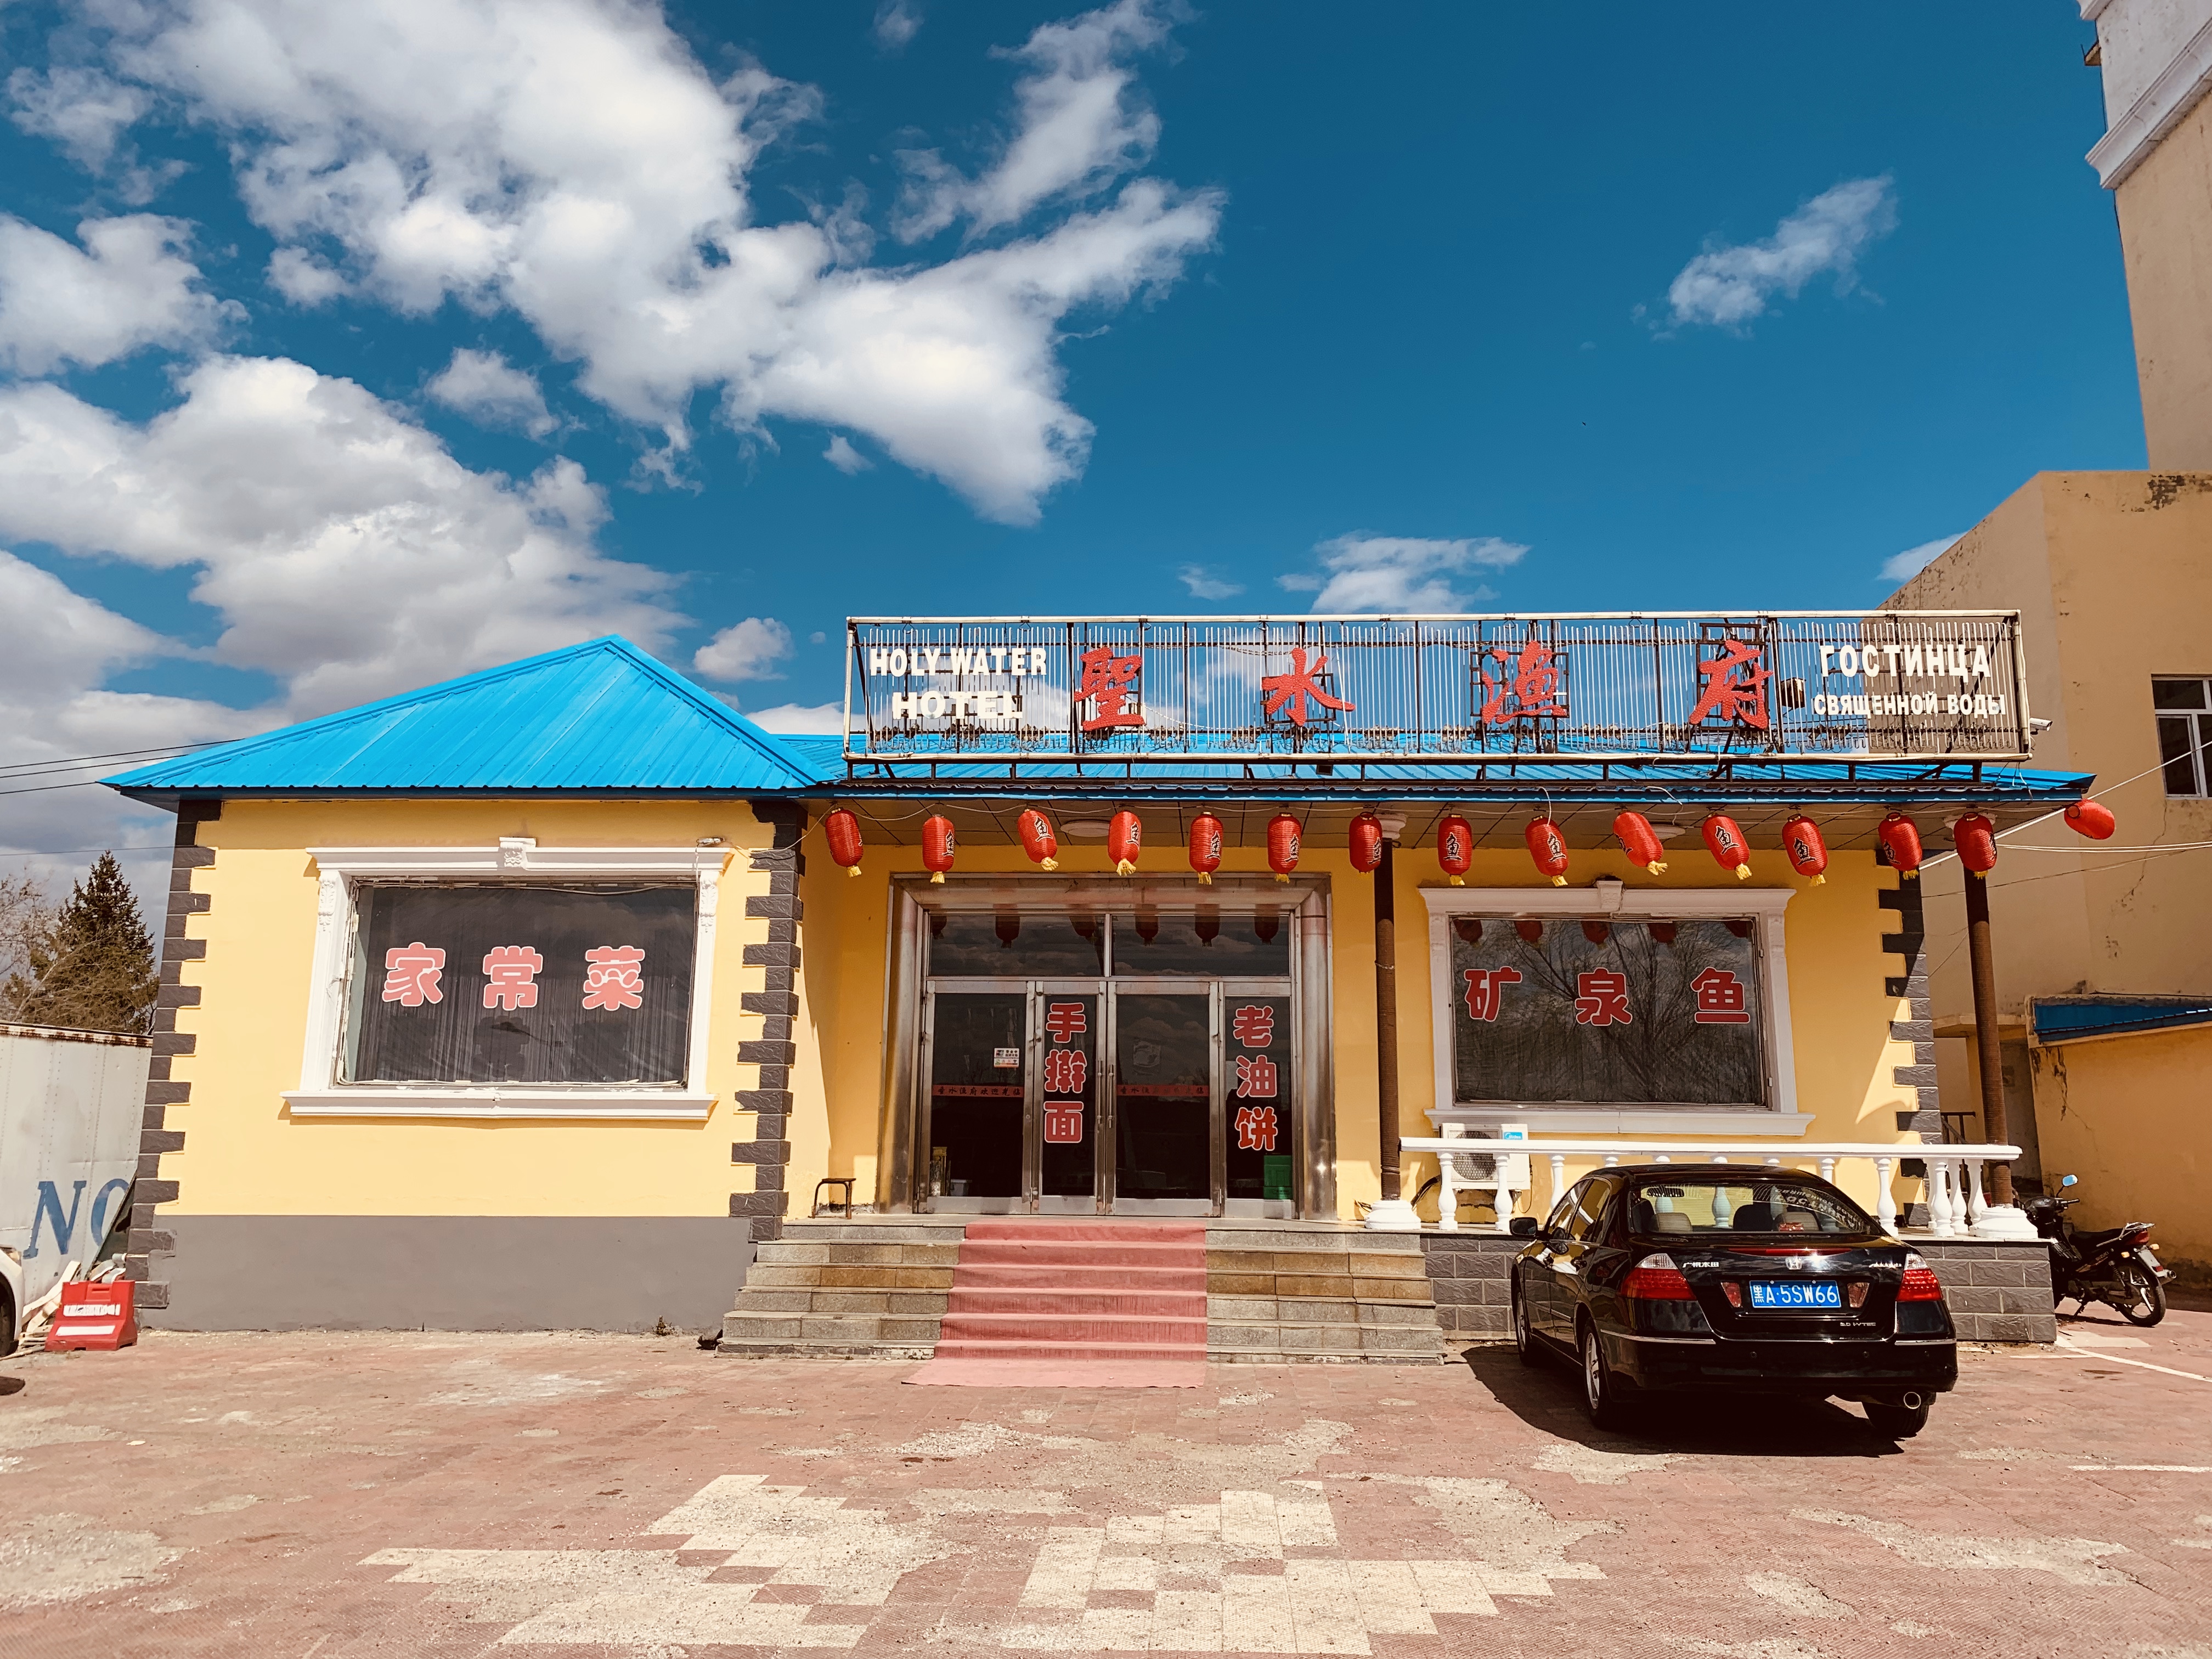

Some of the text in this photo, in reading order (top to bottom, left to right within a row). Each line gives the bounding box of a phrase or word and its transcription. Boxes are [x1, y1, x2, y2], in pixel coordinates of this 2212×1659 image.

[870, 647, 1047, 677] HOLY WATER
[1820, 644, 1991, 683] ГОСТИНЦА
[892, 691, 1023, 720] HOTEL
[1814, 691, 2006, 719] СВЯЩЕННОЙ ВОДЫ
[1443, 832, 1463, 861] 鱼
[1547, 832, 1566, 862] 鱼
[1715, 826, 1740, 855] 鱼
[1793, 837, 1817, 866] 鱼
[382, 942, 645, 1011] 家常菜
[1464, 966, 1750, 1026] 矿泉鱼
[1043, 1002, 1087, 1143] 手擀面
[1233, 1005, 1278, 1151] 老油饼
